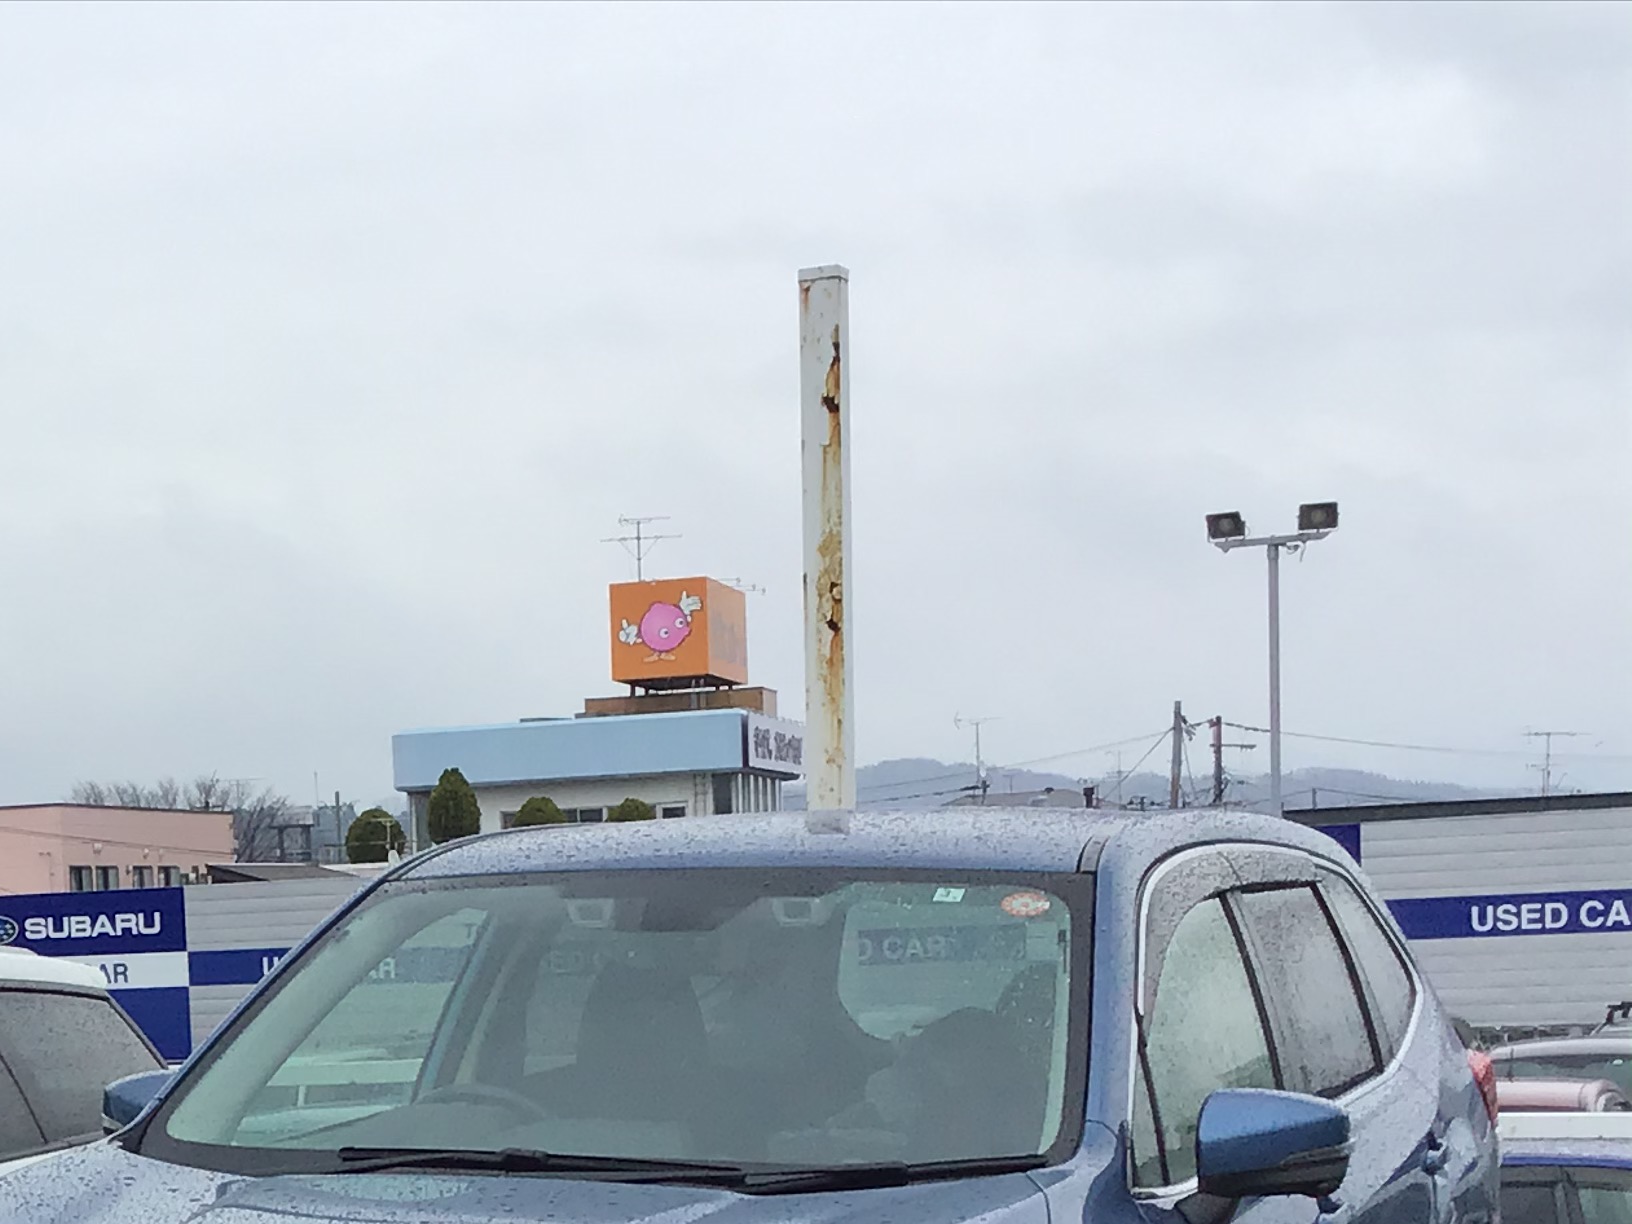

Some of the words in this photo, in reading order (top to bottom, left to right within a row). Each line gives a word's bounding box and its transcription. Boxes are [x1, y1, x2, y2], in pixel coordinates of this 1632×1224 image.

[24, 911, 162, 940] SUBARU
[1471, 902, 1568, 932] USED
[1579, 899, 1632, 928] CA
[100, 963, 129, 984] AR
